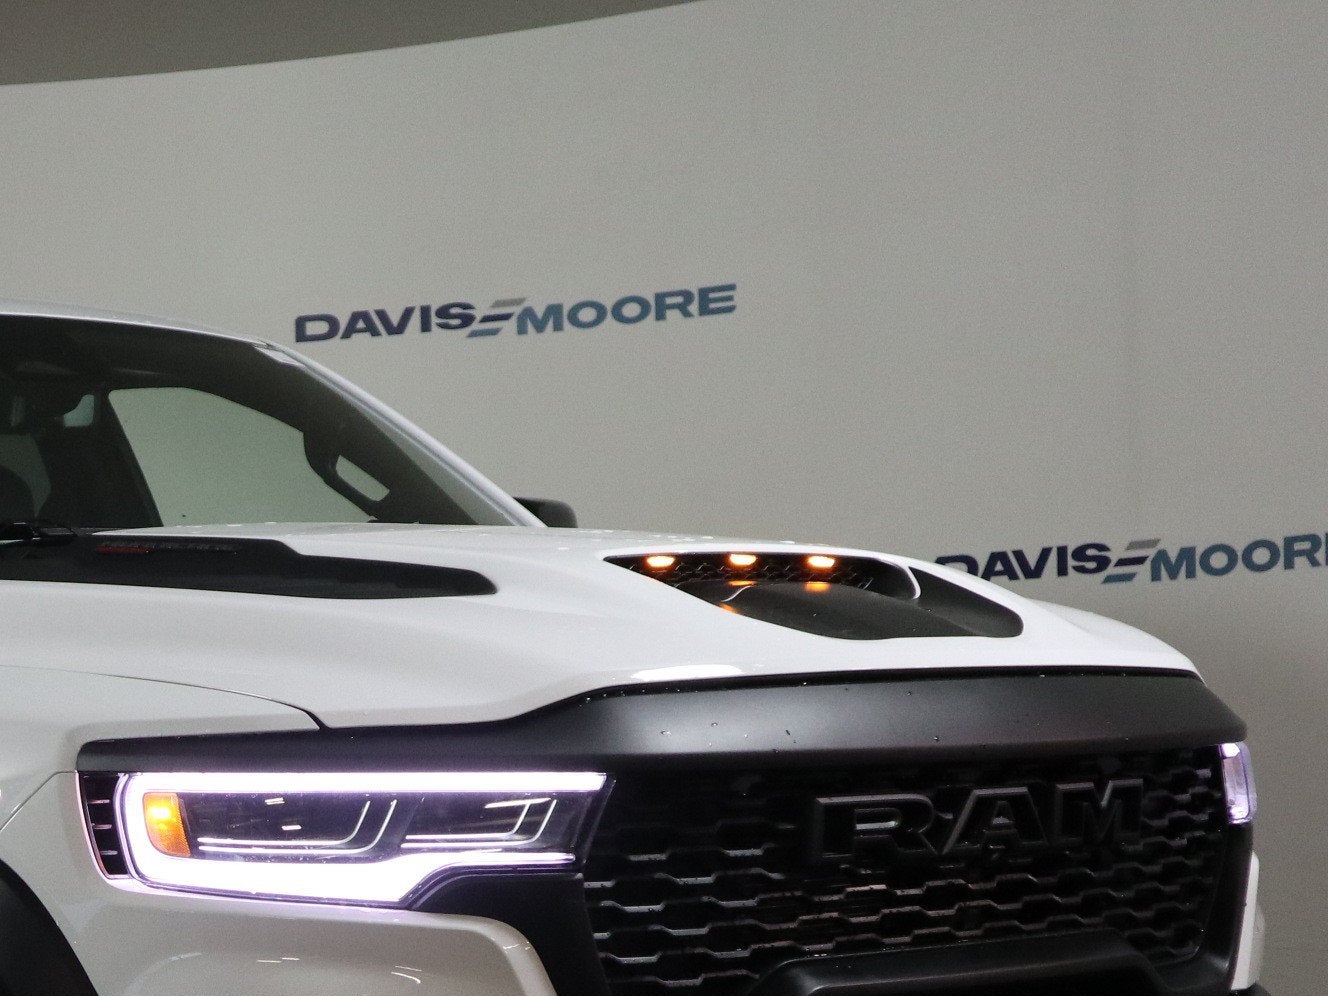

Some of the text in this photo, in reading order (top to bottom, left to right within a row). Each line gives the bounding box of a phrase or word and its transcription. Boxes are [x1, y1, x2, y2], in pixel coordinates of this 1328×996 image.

[294, 283, 737, 342] DAVIS MOORE
[1150, 532, 1328, 582] MOOR
[814, 778, 1145, 859] RAM
